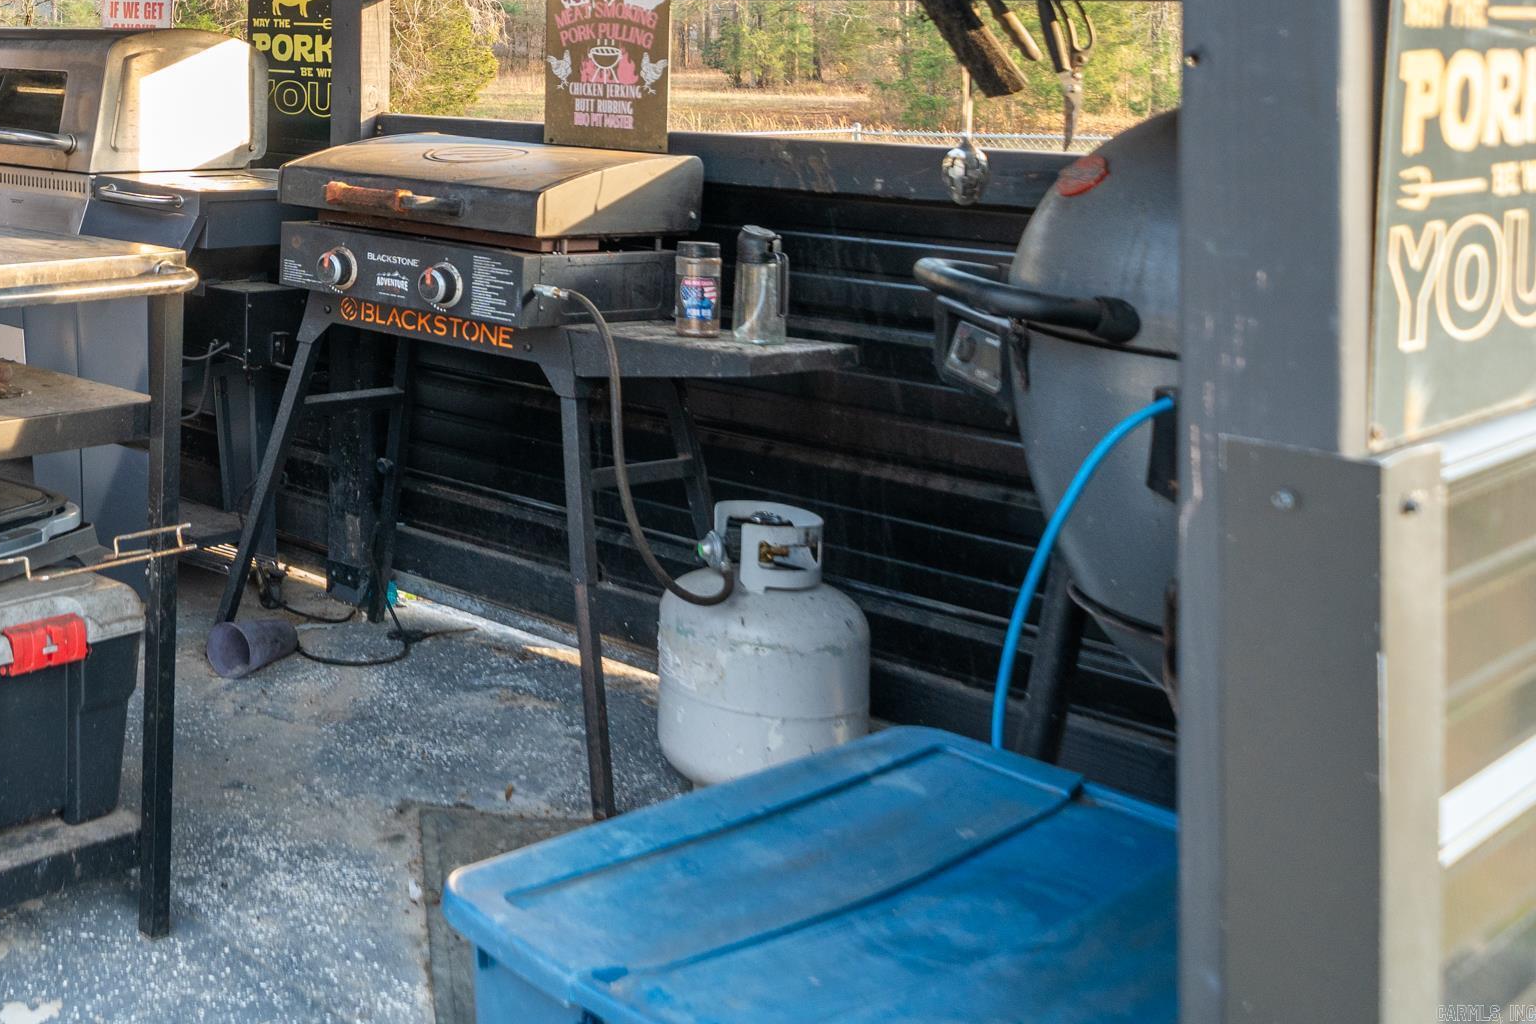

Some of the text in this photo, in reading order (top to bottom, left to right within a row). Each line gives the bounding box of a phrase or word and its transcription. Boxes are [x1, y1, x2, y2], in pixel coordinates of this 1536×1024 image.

[109, 1, 164, 20] IF WE GET
[555, 0, 659, 30] MEAT SMOKING
[253, 17, 291, 28] MAY THE
[560, 23, 654, 49] PORK PULLING
[253, 33, 332, 63] PORK
[300, 67, 313, 77] BE
[569, 82, 642, 99] CHICKEN JERKING
[575, 98, 633, 114] BUTT RUBBING
[367, 252, 419, 268] BLACKSTONE
[376, 275, 409, 292] ADVENTURE
[360, 302, 513, 349] BLACKSTONE
